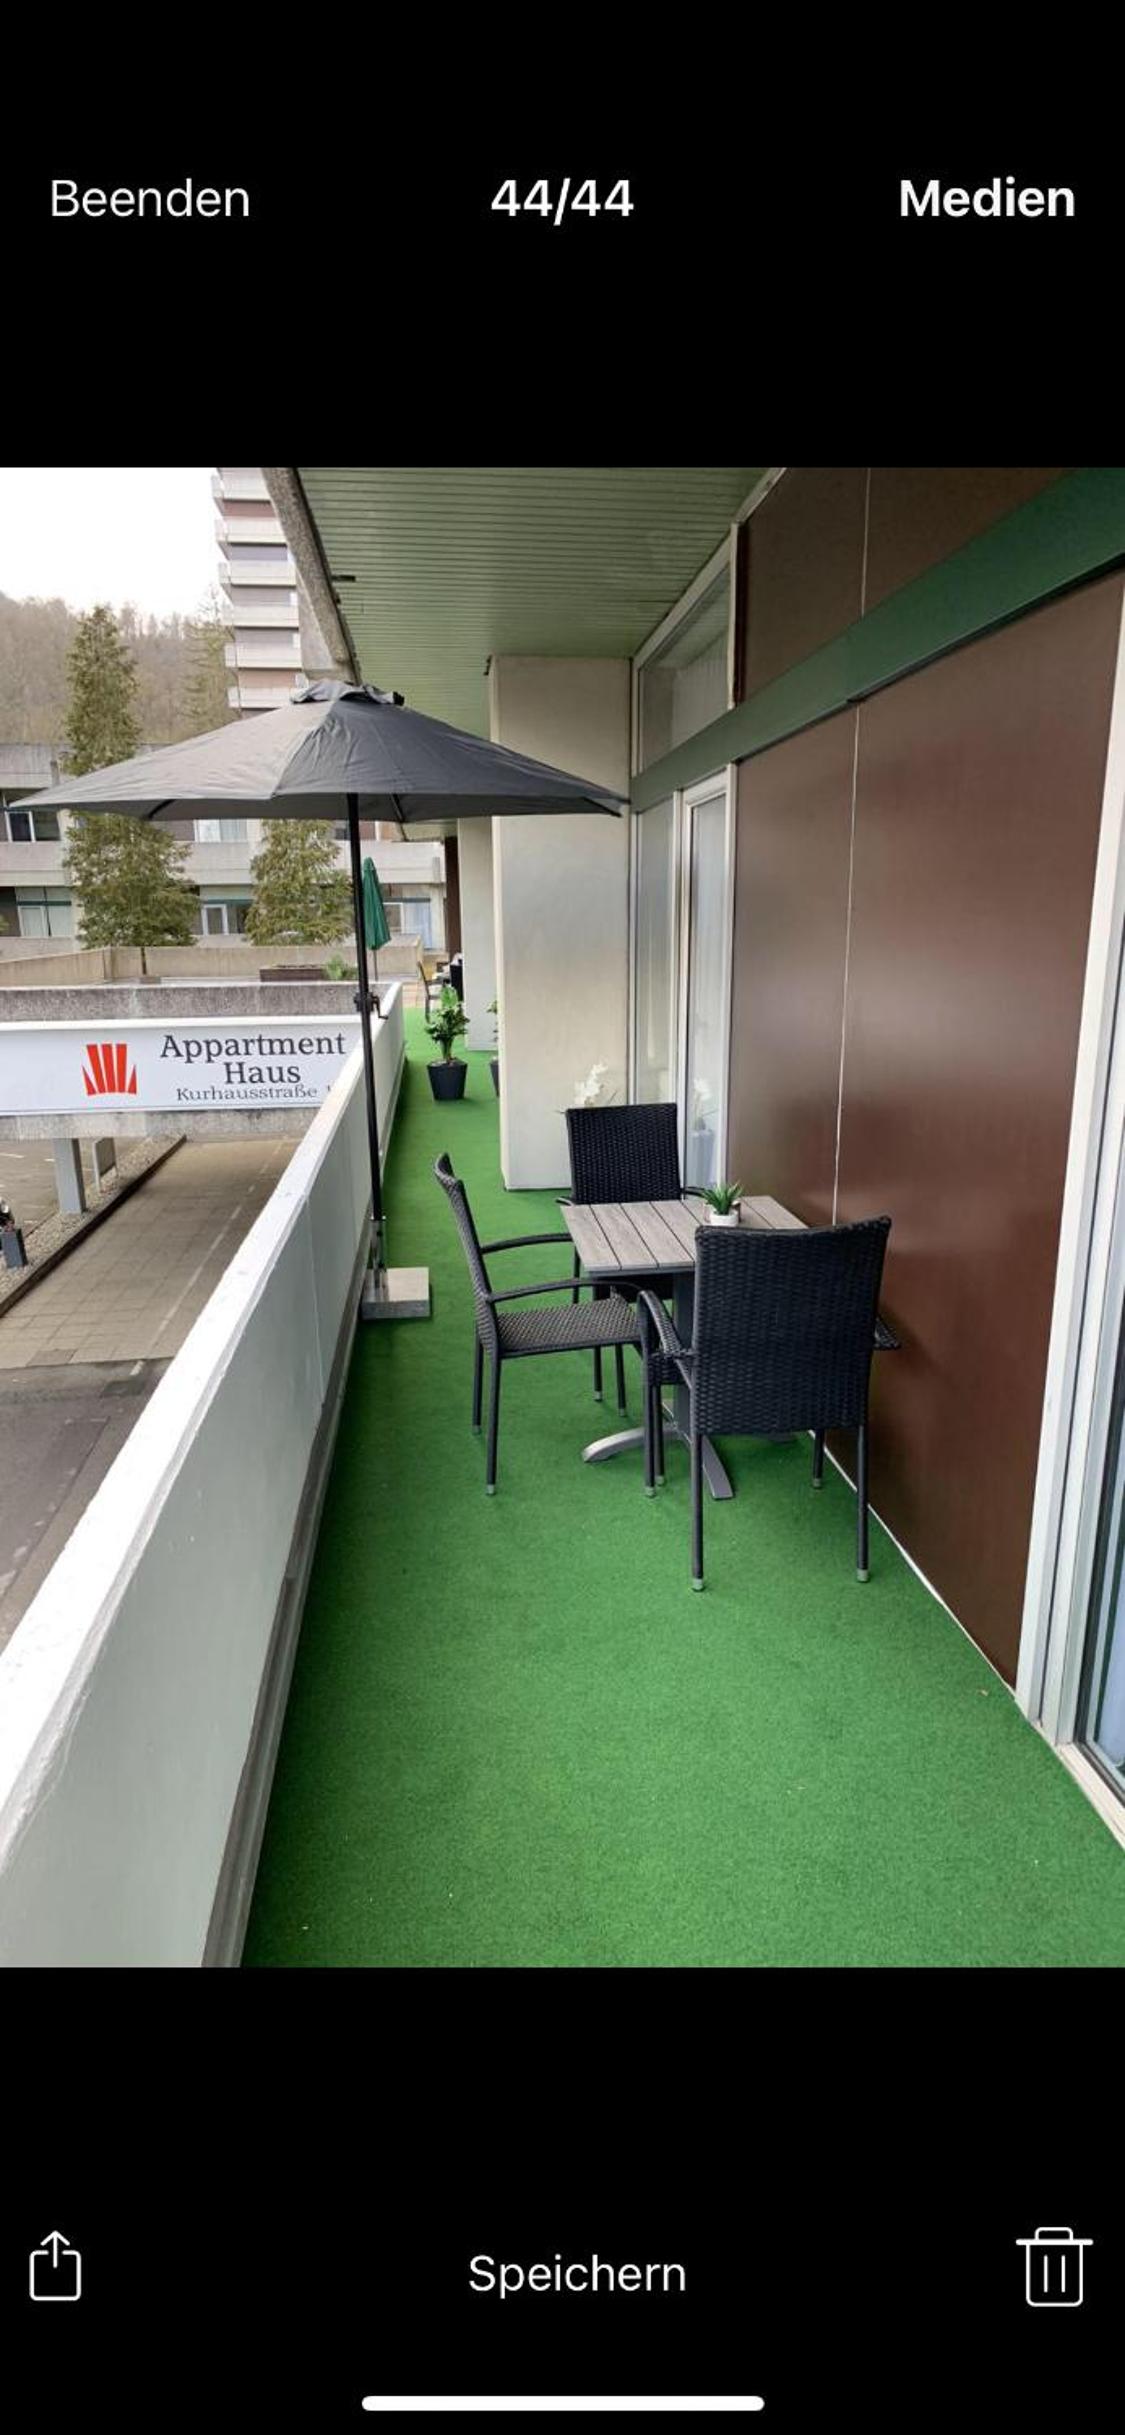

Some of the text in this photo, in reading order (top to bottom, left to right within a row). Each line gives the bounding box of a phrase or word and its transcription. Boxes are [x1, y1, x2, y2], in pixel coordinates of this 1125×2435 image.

[160, 1032, 346, 1063] Appartment
[224, 1062, 302, 1084] Haus
[177, 1085, 318, 1102] Kurhausstraße
